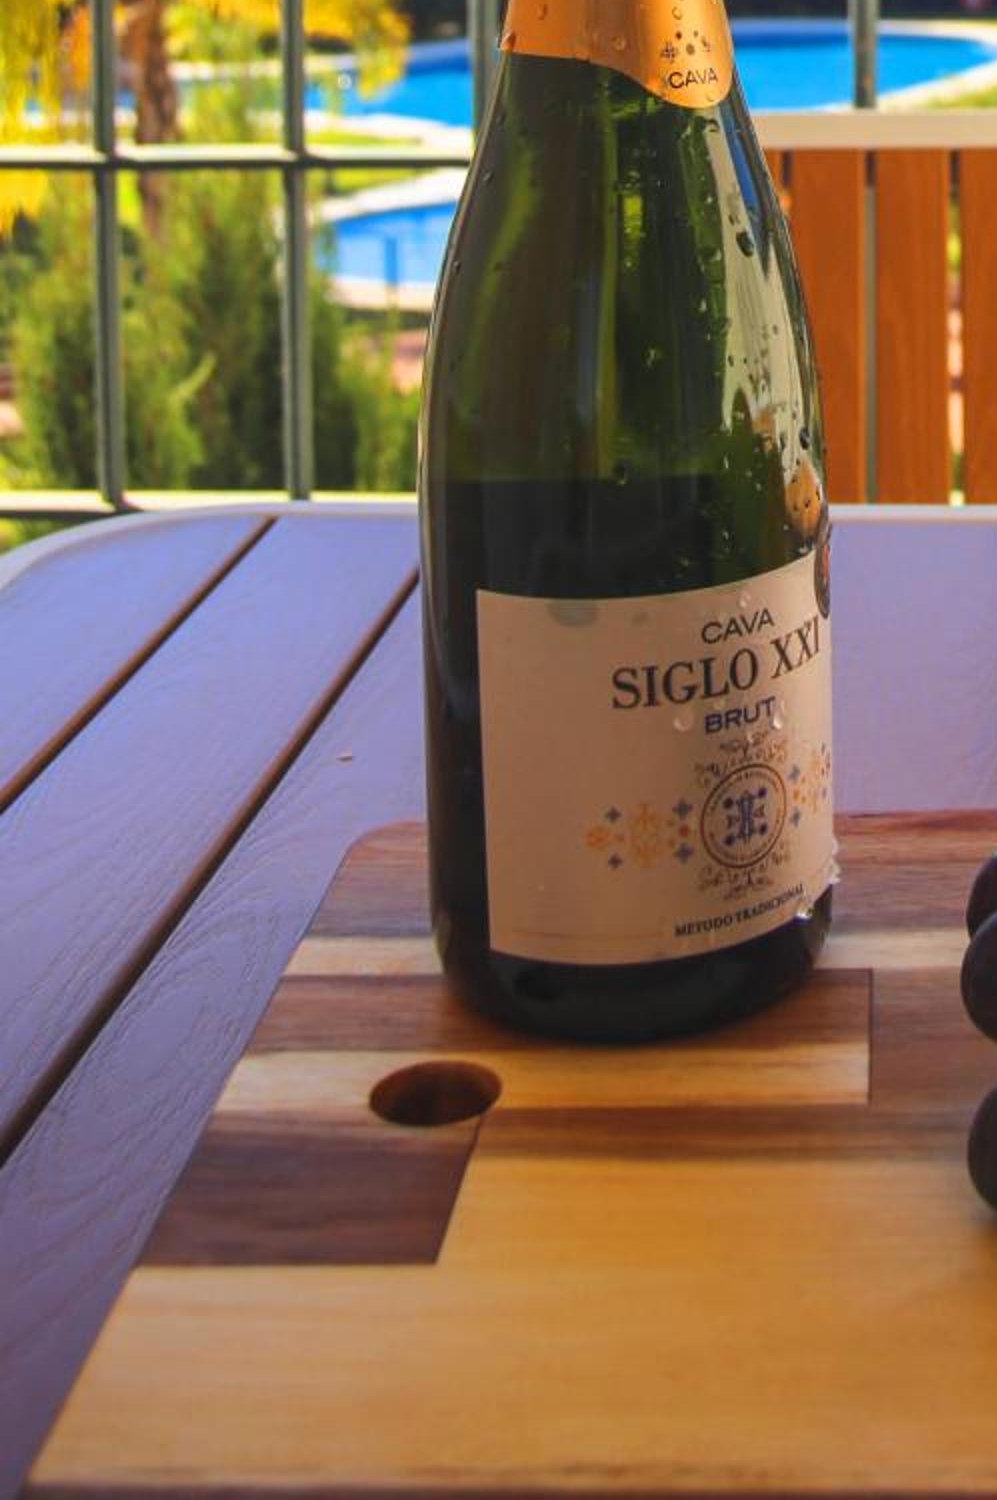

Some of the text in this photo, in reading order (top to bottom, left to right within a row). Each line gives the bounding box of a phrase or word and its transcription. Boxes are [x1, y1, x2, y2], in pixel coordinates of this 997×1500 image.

[668, 67, 719, 89] CAVA
[701, 608, 775, 645] CAVA
[611, 614, 820, 709] SIGLO XXI
[704, 696, 777, 734] BRUT
